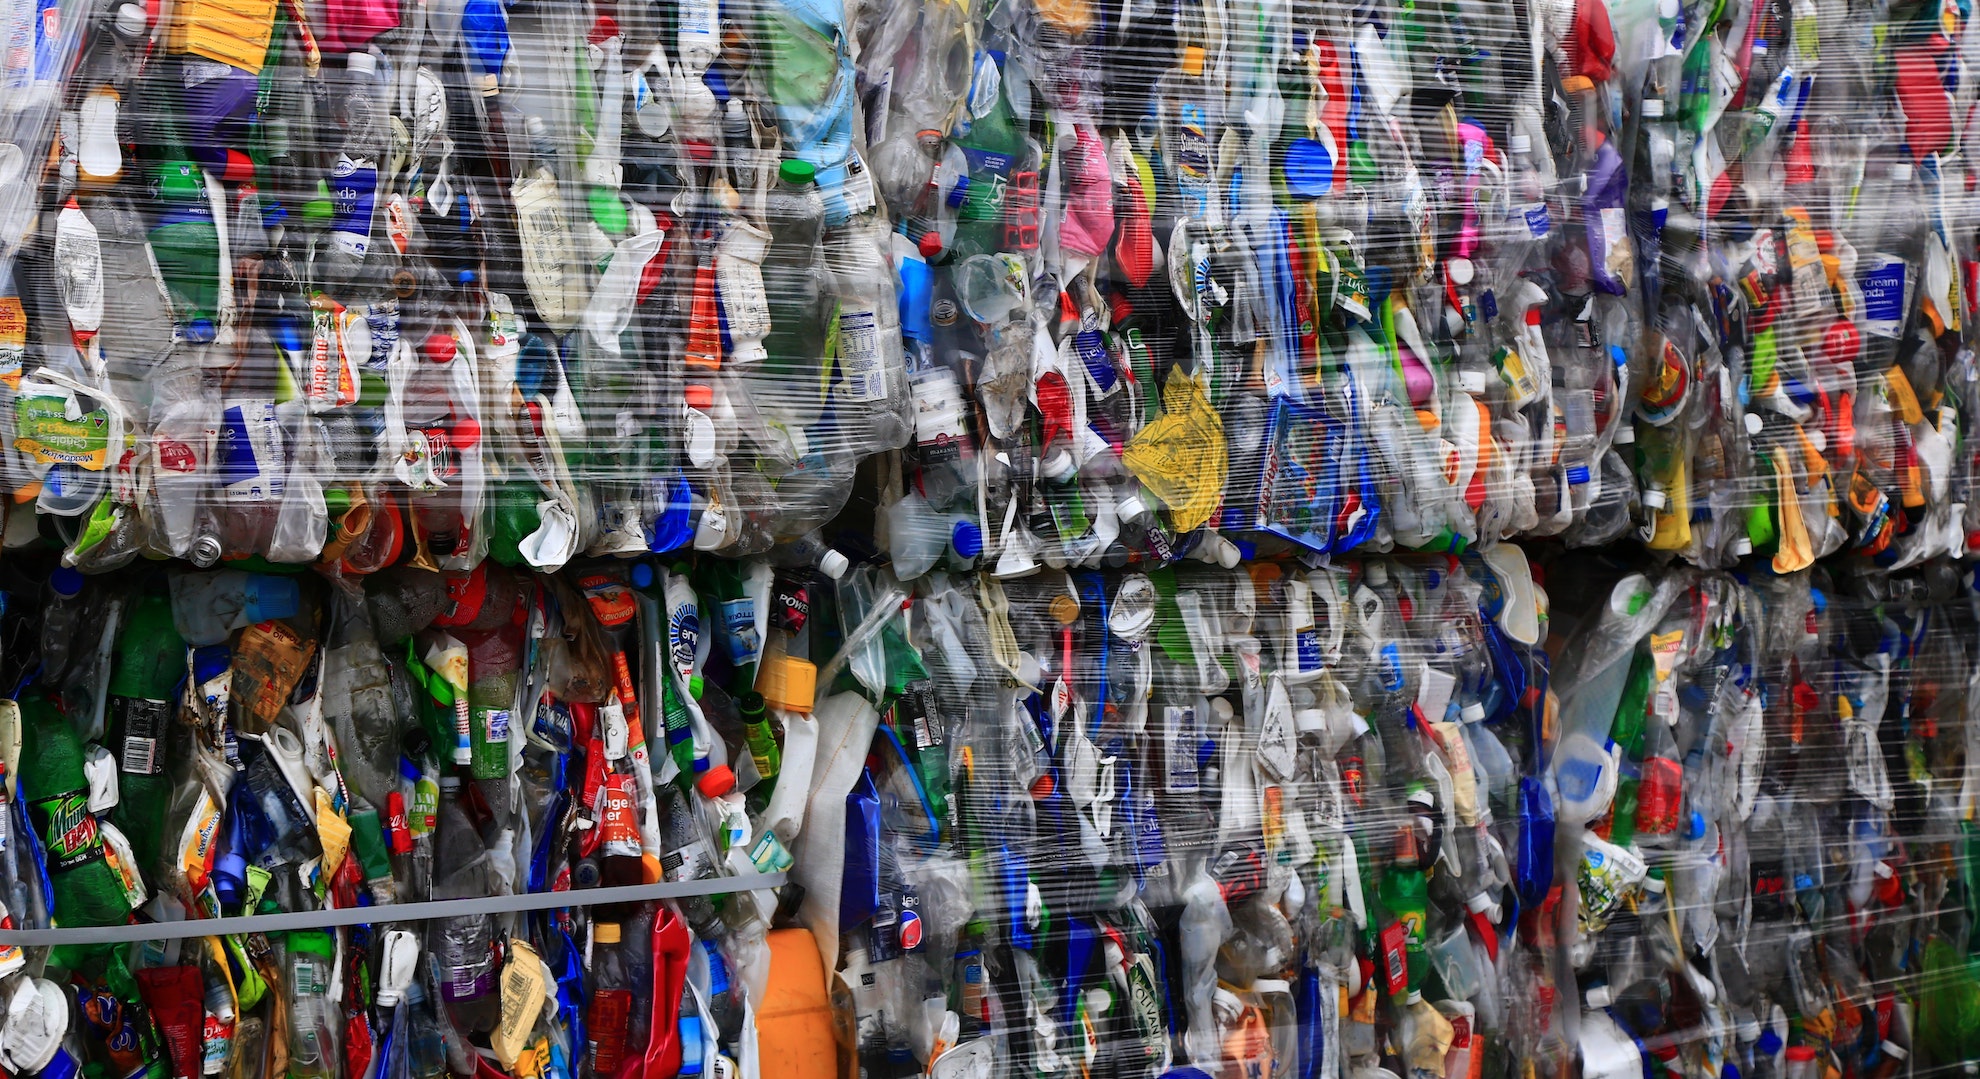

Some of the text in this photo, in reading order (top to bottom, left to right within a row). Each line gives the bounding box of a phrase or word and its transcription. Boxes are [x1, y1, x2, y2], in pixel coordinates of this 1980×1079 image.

[36, 421, 89, 440] Omega 3
[49, 434, 87, 449] Canola
[600, 605, 634, 622] EDMONDS
[272, 630, 284, 643] OIL
